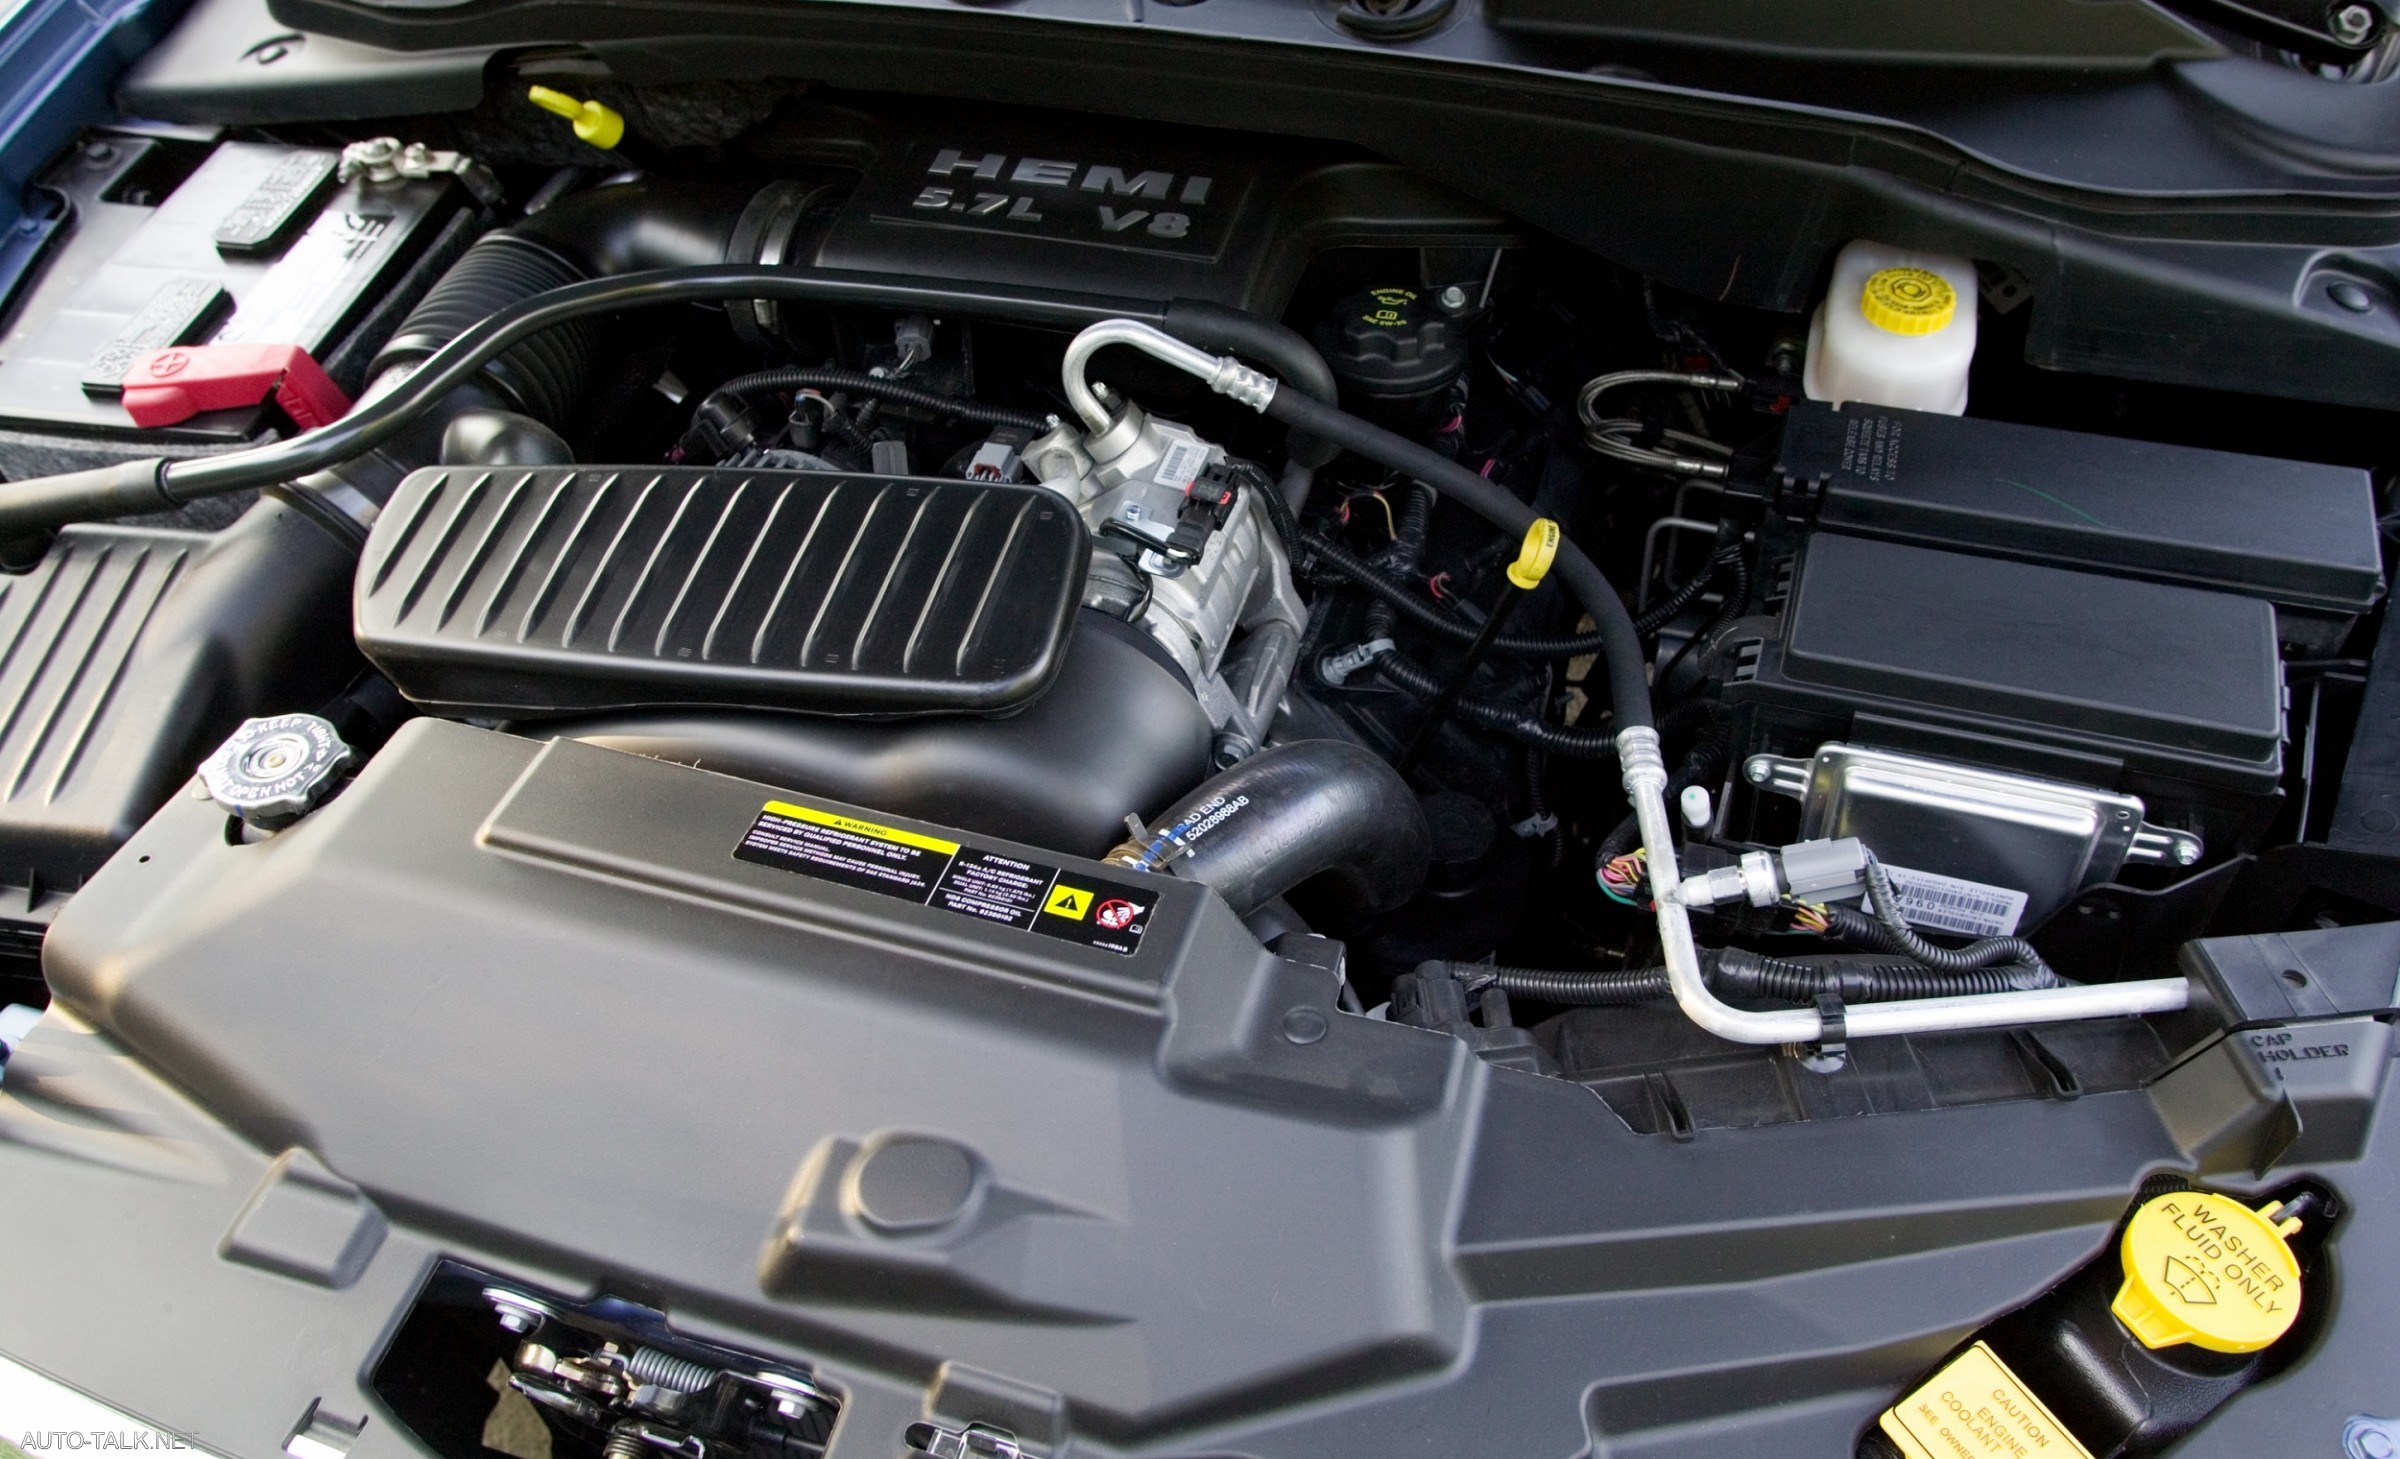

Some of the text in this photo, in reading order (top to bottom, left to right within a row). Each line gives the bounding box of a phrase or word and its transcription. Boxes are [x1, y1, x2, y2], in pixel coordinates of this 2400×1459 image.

[927, 149, 1212, 205] HEMI
[912, 186, 1191, 238] 5.7L V8
[1370, 288, 1404, 296] ENGINE
[257, 718, 331, 749] KEEP TIGHT
[229, 785, 272, 798] OPEN
[275, 772, 305, 794] HOT
[1185, 795, 1249, 841] 52028988AB
[1199, 796, 1226, 815] END
[751, 829, 779, 839] CONSULT
[779, 835, 805, 846] SERVICE
[757, 820, 909, 861] SERVICED BY QUALIFIED PERSONNEL ONLY.
[761, 814, 922, 857] HIGH-PRESSURE REFRIGERANT SYSTEM TO BE
[844, 821, 888, 836] WARNING
[745, 839, 768, 849] SYSTEM
[768, 845, 788, 854] MEETS
[788, 850, 811, 859] SAFETY
[810, 855, 856, 870] REQUIREMENTS
[878, 871, 910, 884] STANDARD
[748, 834, 779, 845] IMPROPER
[779, 841, 804, 852] SERVICE
[804, 847, 833, 859] METHODS
[832, 854, 846, 862] MAY
[846, 858, 867, 867] CAUSE
[866, 862, 898, 874] PERSONAL
[982, 854, 1030, 870] ATTENTION
[957, 860, 1043, 885] R-134a A/C REFRIGERANT
[965, 869, 1029, 889] FACTORY CHARGE:
[946, 900, 966, 910] PART
[960, 896, 1010, 913] COMPRESSOR
[1008, 908, 1023, 916] OIL
[2251, 1033, 2293, 1048] CAP
[2257, 1044, 2350, 1063] HOLDER
[2161, 1202, 2283, 1313] FLUID ONLY
[2194, 1204, 2285, 1292] WASHER
[1918, 1403, 1977, 1459] SEE OWNE
[1941, 1391, 2003, 1454] COOLANT
[1976, 1407, 2028, 1459] ENGINE
[1992, 1388, 2050, 1448] CAUTION
